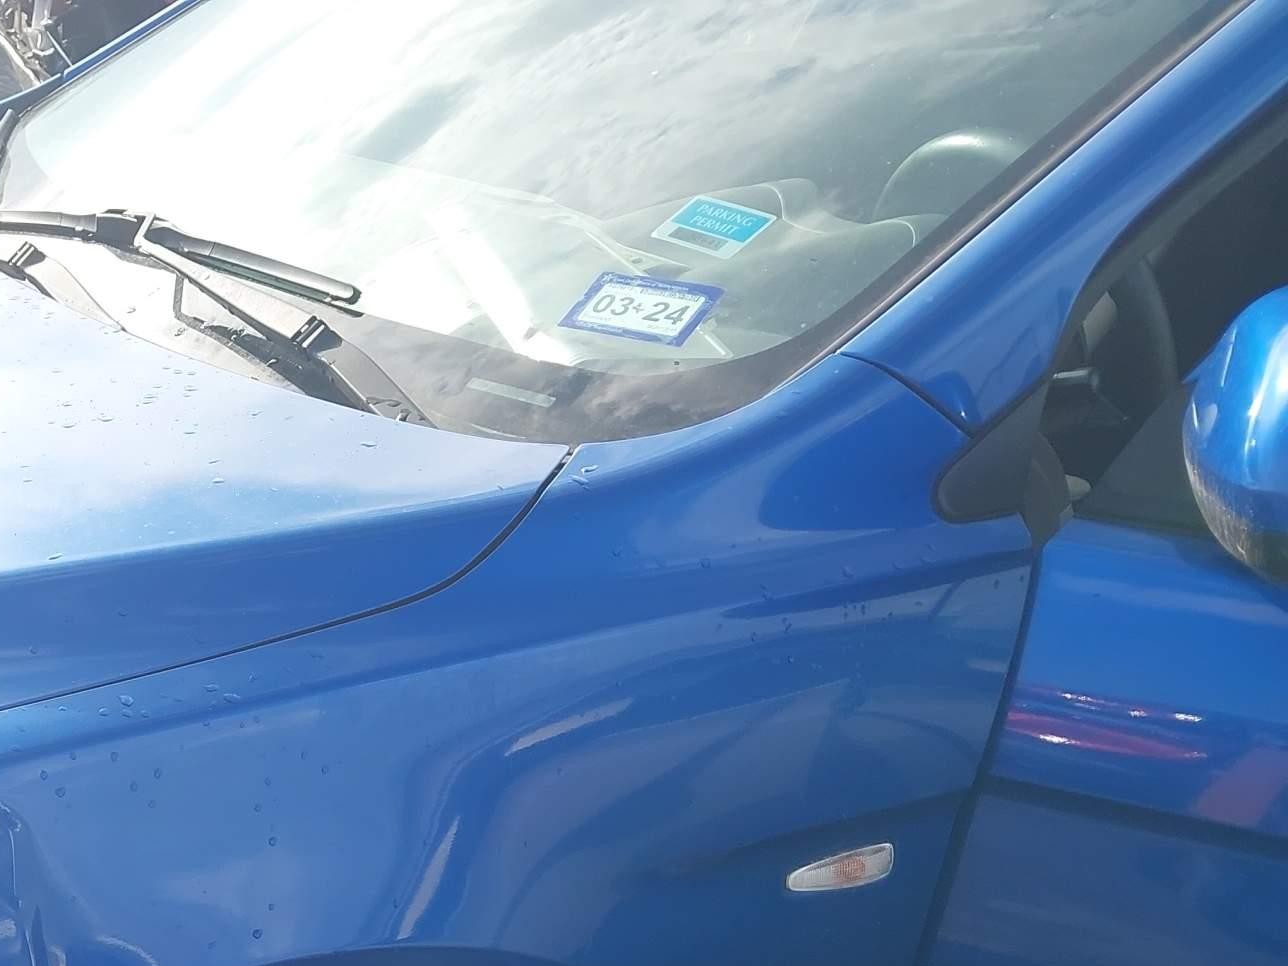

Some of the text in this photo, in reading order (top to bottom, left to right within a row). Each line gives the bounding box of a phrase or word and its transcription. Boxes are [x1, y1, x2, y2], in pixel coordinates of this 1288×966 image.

[690, 215, 739, 235] PERMIT
[697, 204, 756, 226] PARKING
[593, 294, 690, 325] 03 24
